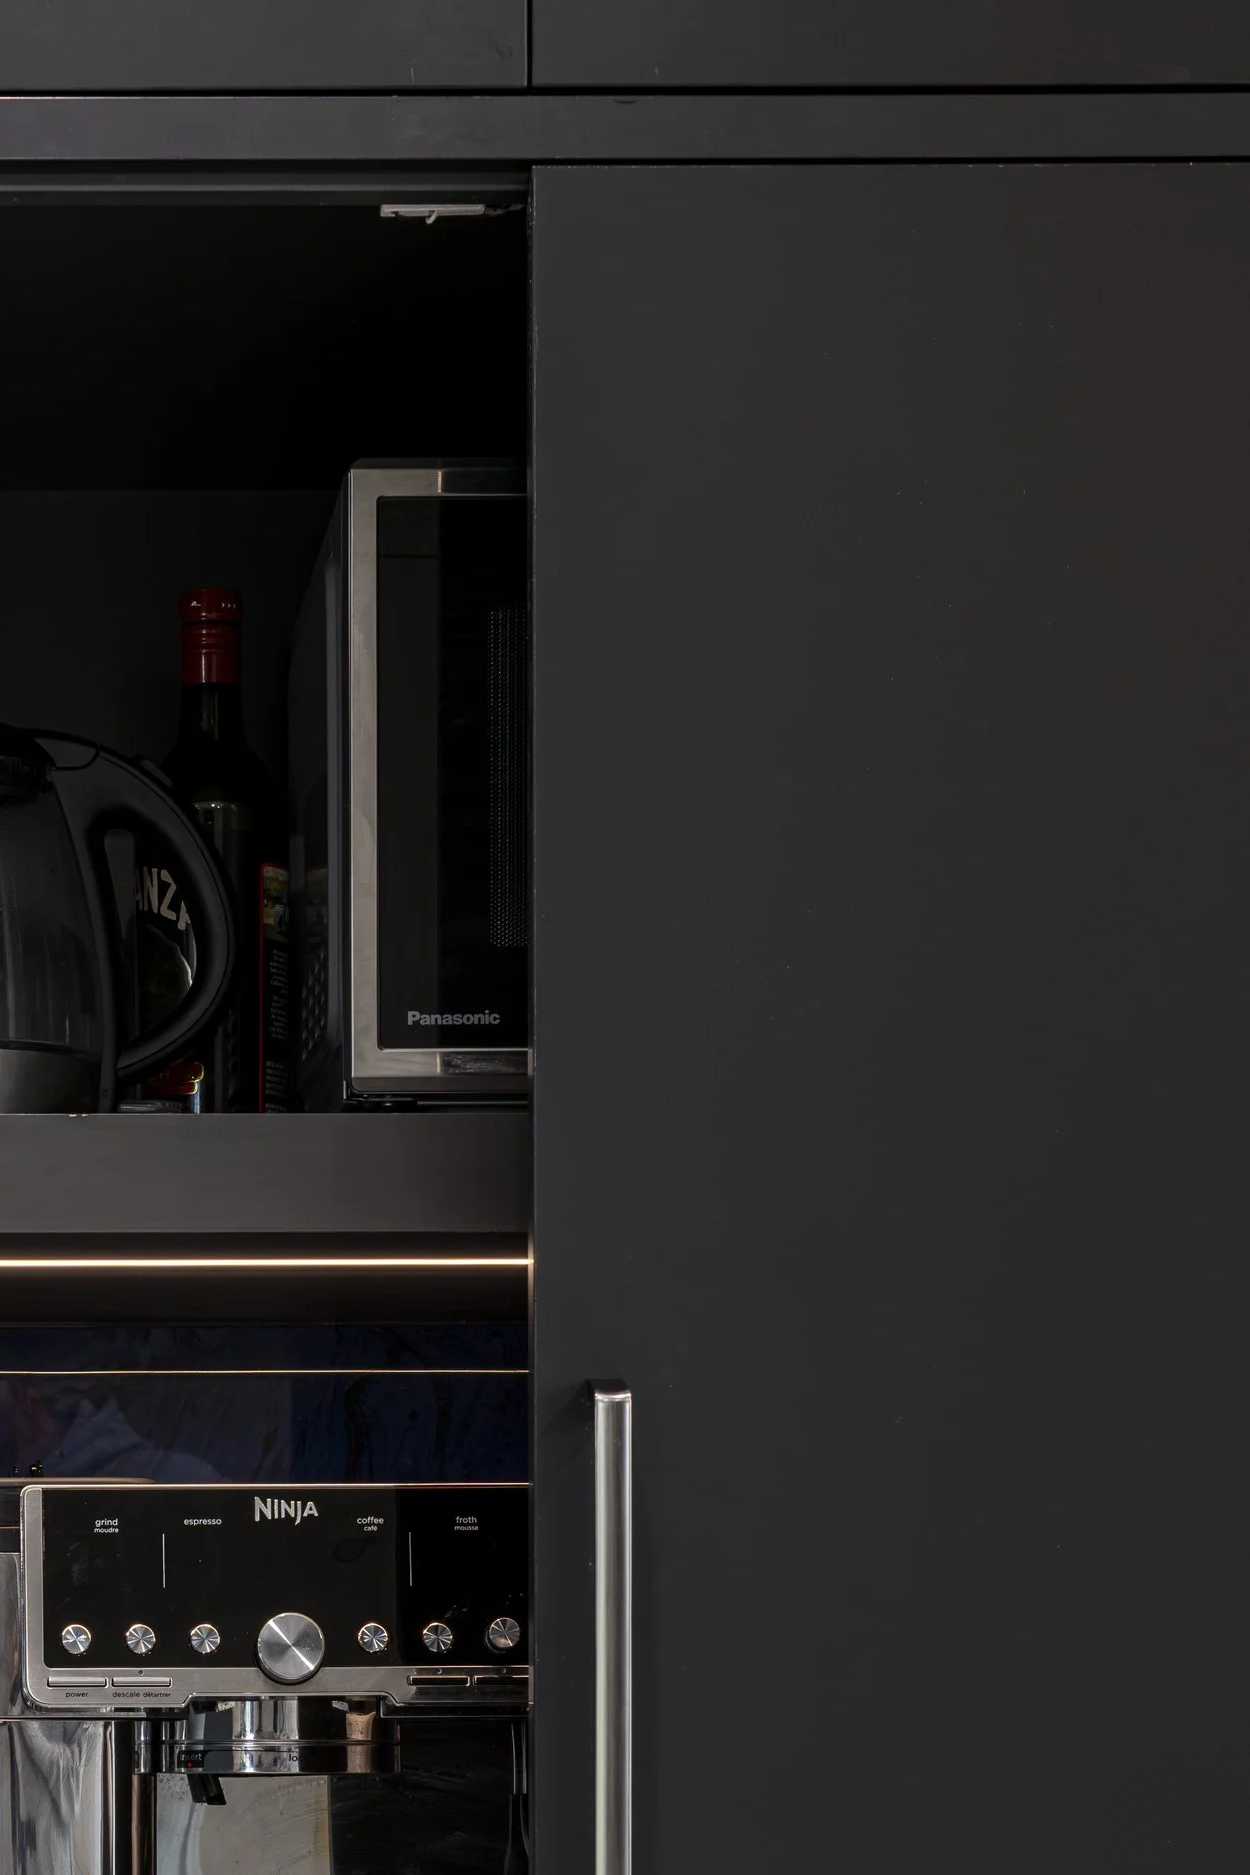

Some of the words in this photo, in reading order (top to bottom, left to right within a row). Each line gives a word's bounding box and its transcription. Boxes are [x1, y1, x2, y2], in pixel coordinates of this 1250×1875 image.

[407, 1010, 500, 1026] Panasonic
[254, 1496, 319, 1526] NINJA
[95, 1518, 118, 1528] grind
[183, 1517, 222, 1527] espresso
[356, 1516, 385, 1525] coffee
[455, 1515, 478, 1524] froth
[94, 1526, 119, 1534] moudre
[363, 1524, 378, 1532] café
